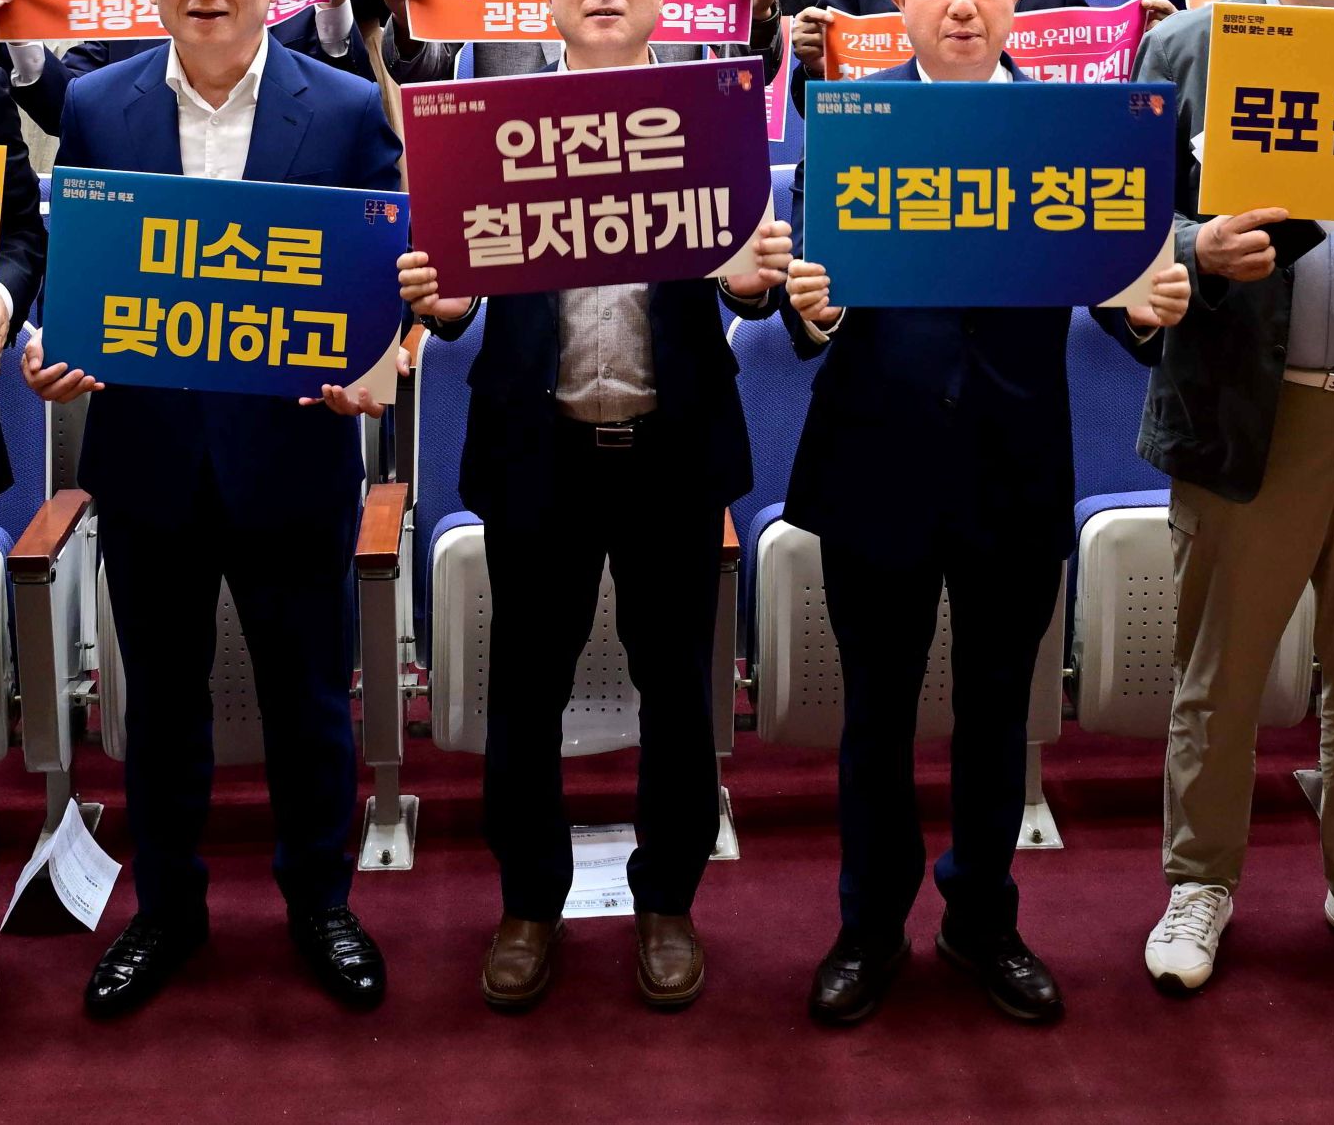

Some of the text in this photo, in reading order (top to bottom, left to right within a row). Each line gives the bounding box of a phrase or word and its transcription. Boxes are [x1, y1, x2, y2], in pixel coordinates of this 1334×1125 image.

[496, 107, 685, 182] 안전은
[1230, 87, 1320, 153] 목포
[463, 187, 733, 267] 철저하게!
[835, 166, 1145, 232] 친절과 청결
[140, 217, 323, 285] 미소로
[102, 295, 347, 369] 맞이하고
